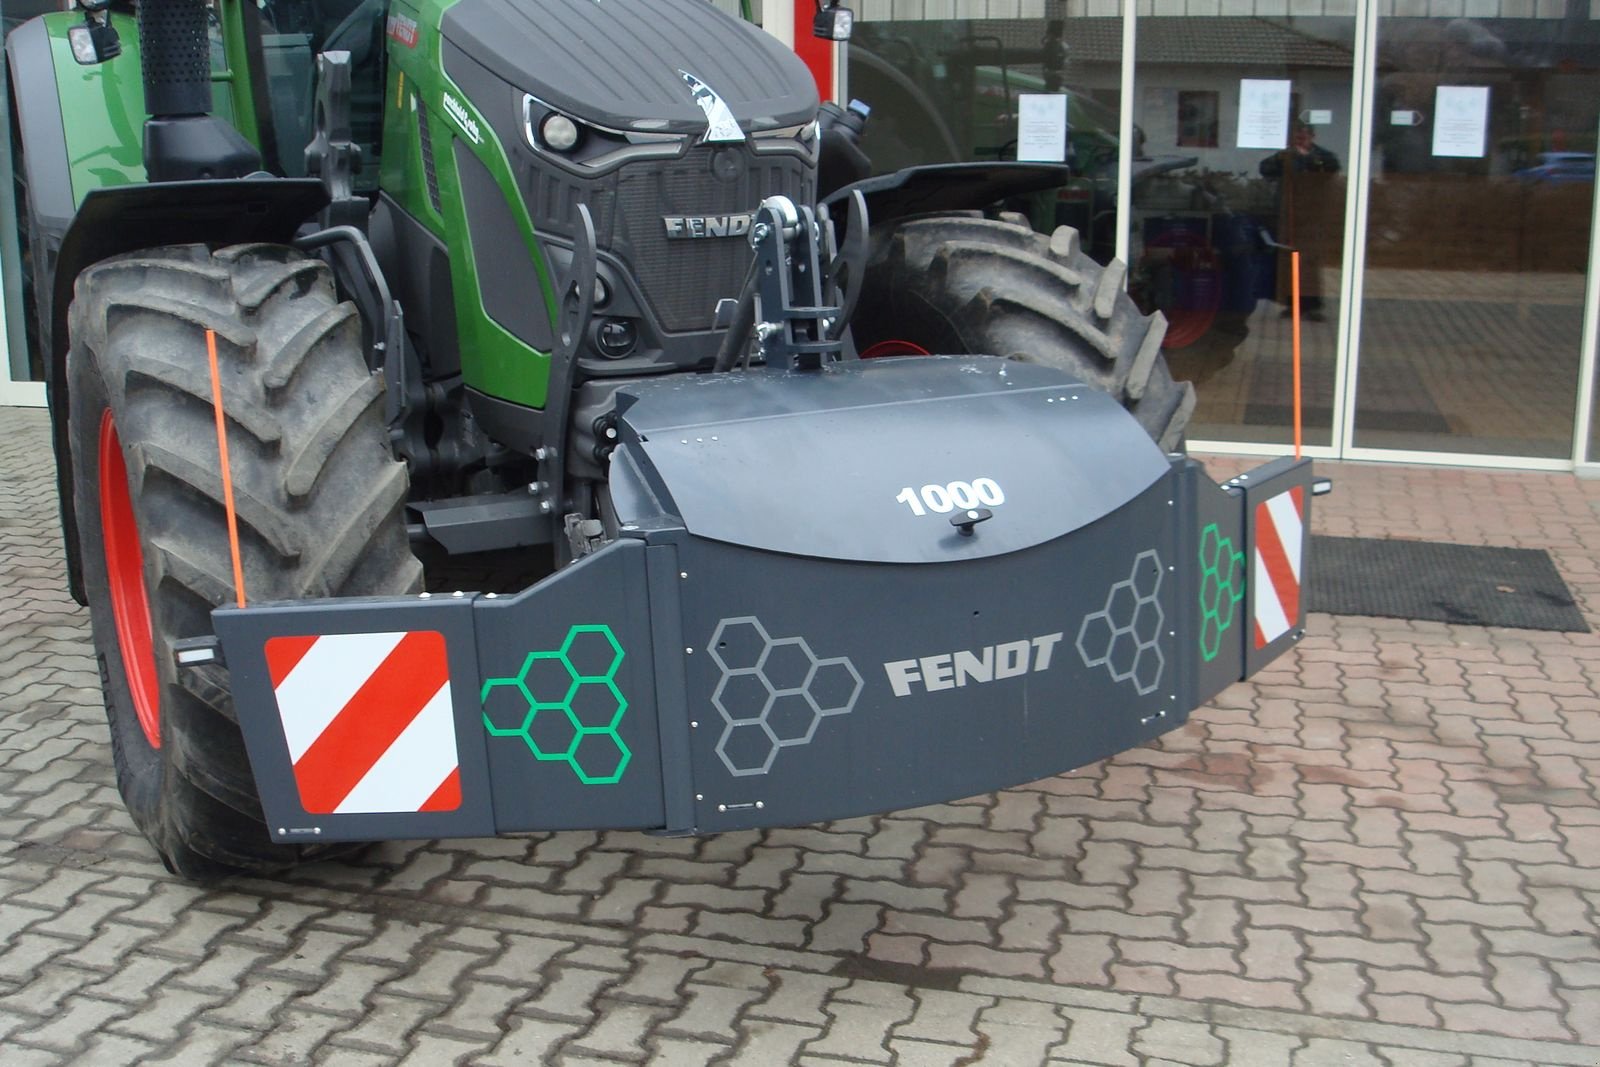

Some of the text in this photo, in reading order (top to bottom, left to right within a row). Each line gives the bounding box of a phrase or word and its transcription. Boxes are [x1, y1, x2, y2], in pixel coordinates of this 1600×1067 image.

[664, 215, 754, 238] FEND
[896, 477, 1005, 516] 1000
[883, 632, 1063, 697] FENDT
